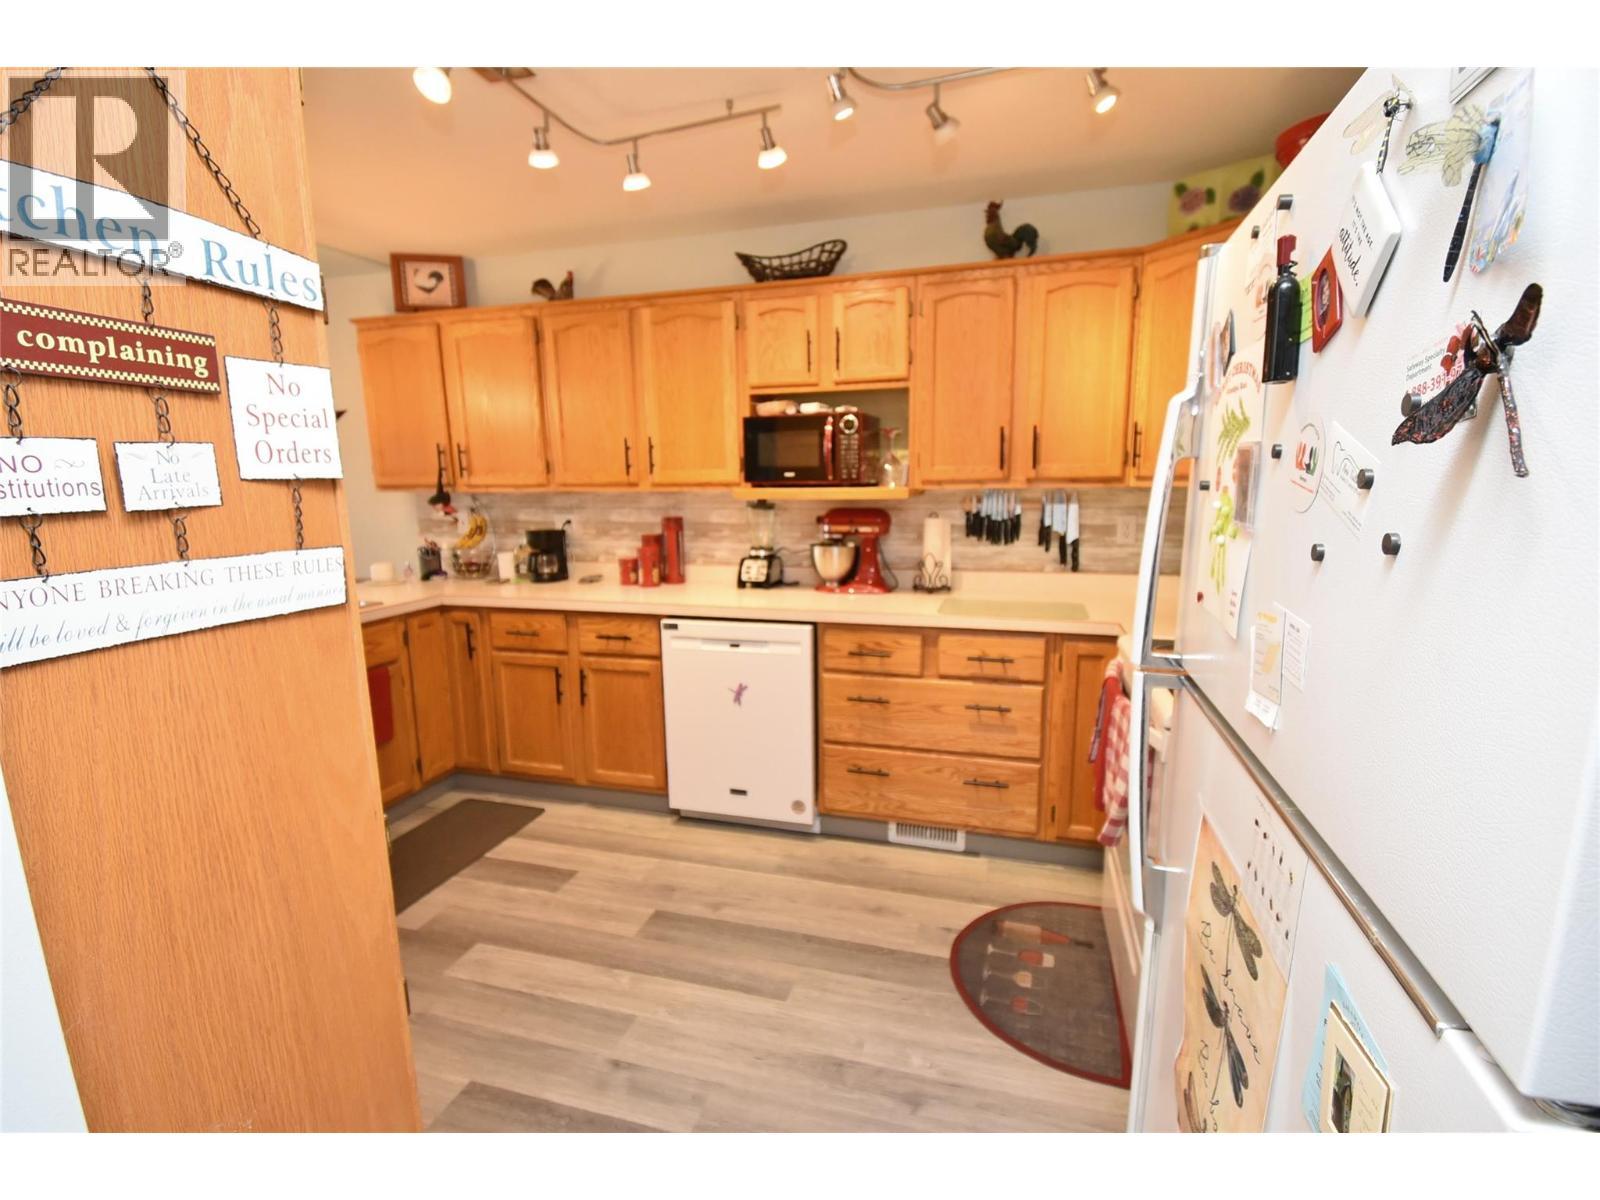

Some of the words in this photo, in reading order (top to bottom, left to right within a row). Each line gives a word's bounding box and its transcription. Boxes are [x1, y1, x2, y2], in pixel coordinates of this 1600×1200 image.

[200, 237, 318, 301] Rules
[17, 329, 209, 378] complaining
[266, 373, 301, 397] No
[246, 404, 329, 436] Special
[0, 455, 42, 473] NO
[155, 450, 180, 465] No
[255, 439, 332, 465] Orders
[150, 468, 191, 484] Late
[138, 482, 210, 501] Arrivals
[100, 569, 214, 599] BREAKING
[223, 561, 285, 583] THESE
[292, 556, 343, 576] RULES
[29, 624, 51, 647] be
[56, 613, 111, 643] loved
[116, 613, 131, 633] &
[135, 605, 208, 640] forgiven
[212, 602, 228, 616] in
[232, 592, 251, 612] the
[256, 584, 296, 607] usual
